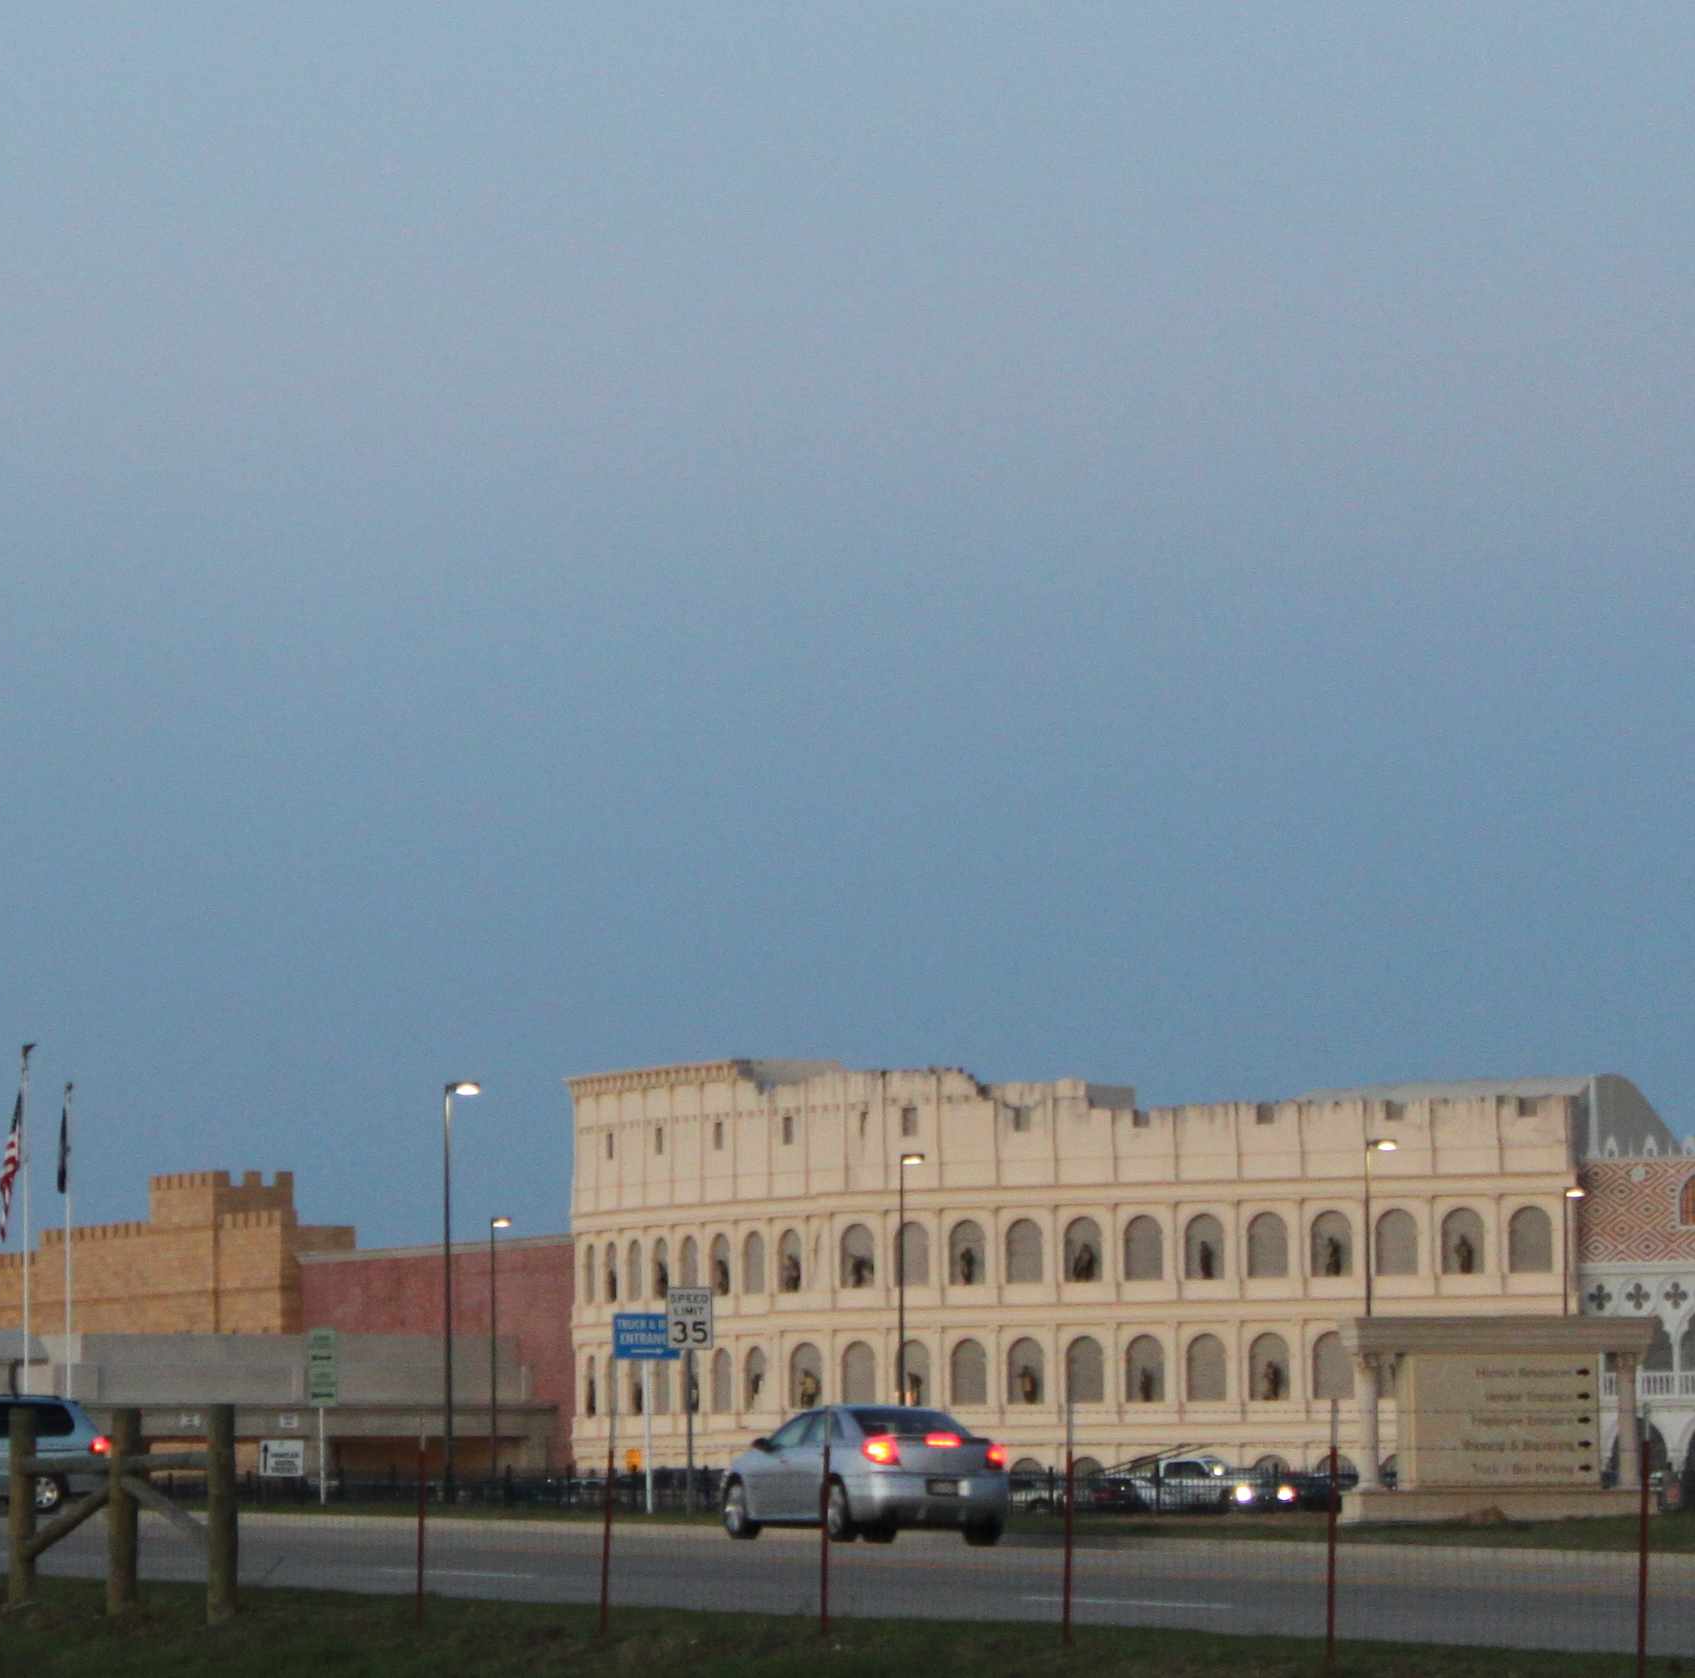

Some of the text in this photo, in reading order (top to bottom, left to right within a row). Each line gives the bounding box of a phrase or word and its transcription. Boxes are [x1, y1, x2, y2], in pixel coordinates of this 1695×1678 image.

[671, 1294, 708, 1304] SPEED
[673, 1305, 704, 1316] LIMIT
[616, 1319, 646, 1329] TRUCK
[672, 1320, 708, 1343] 35
